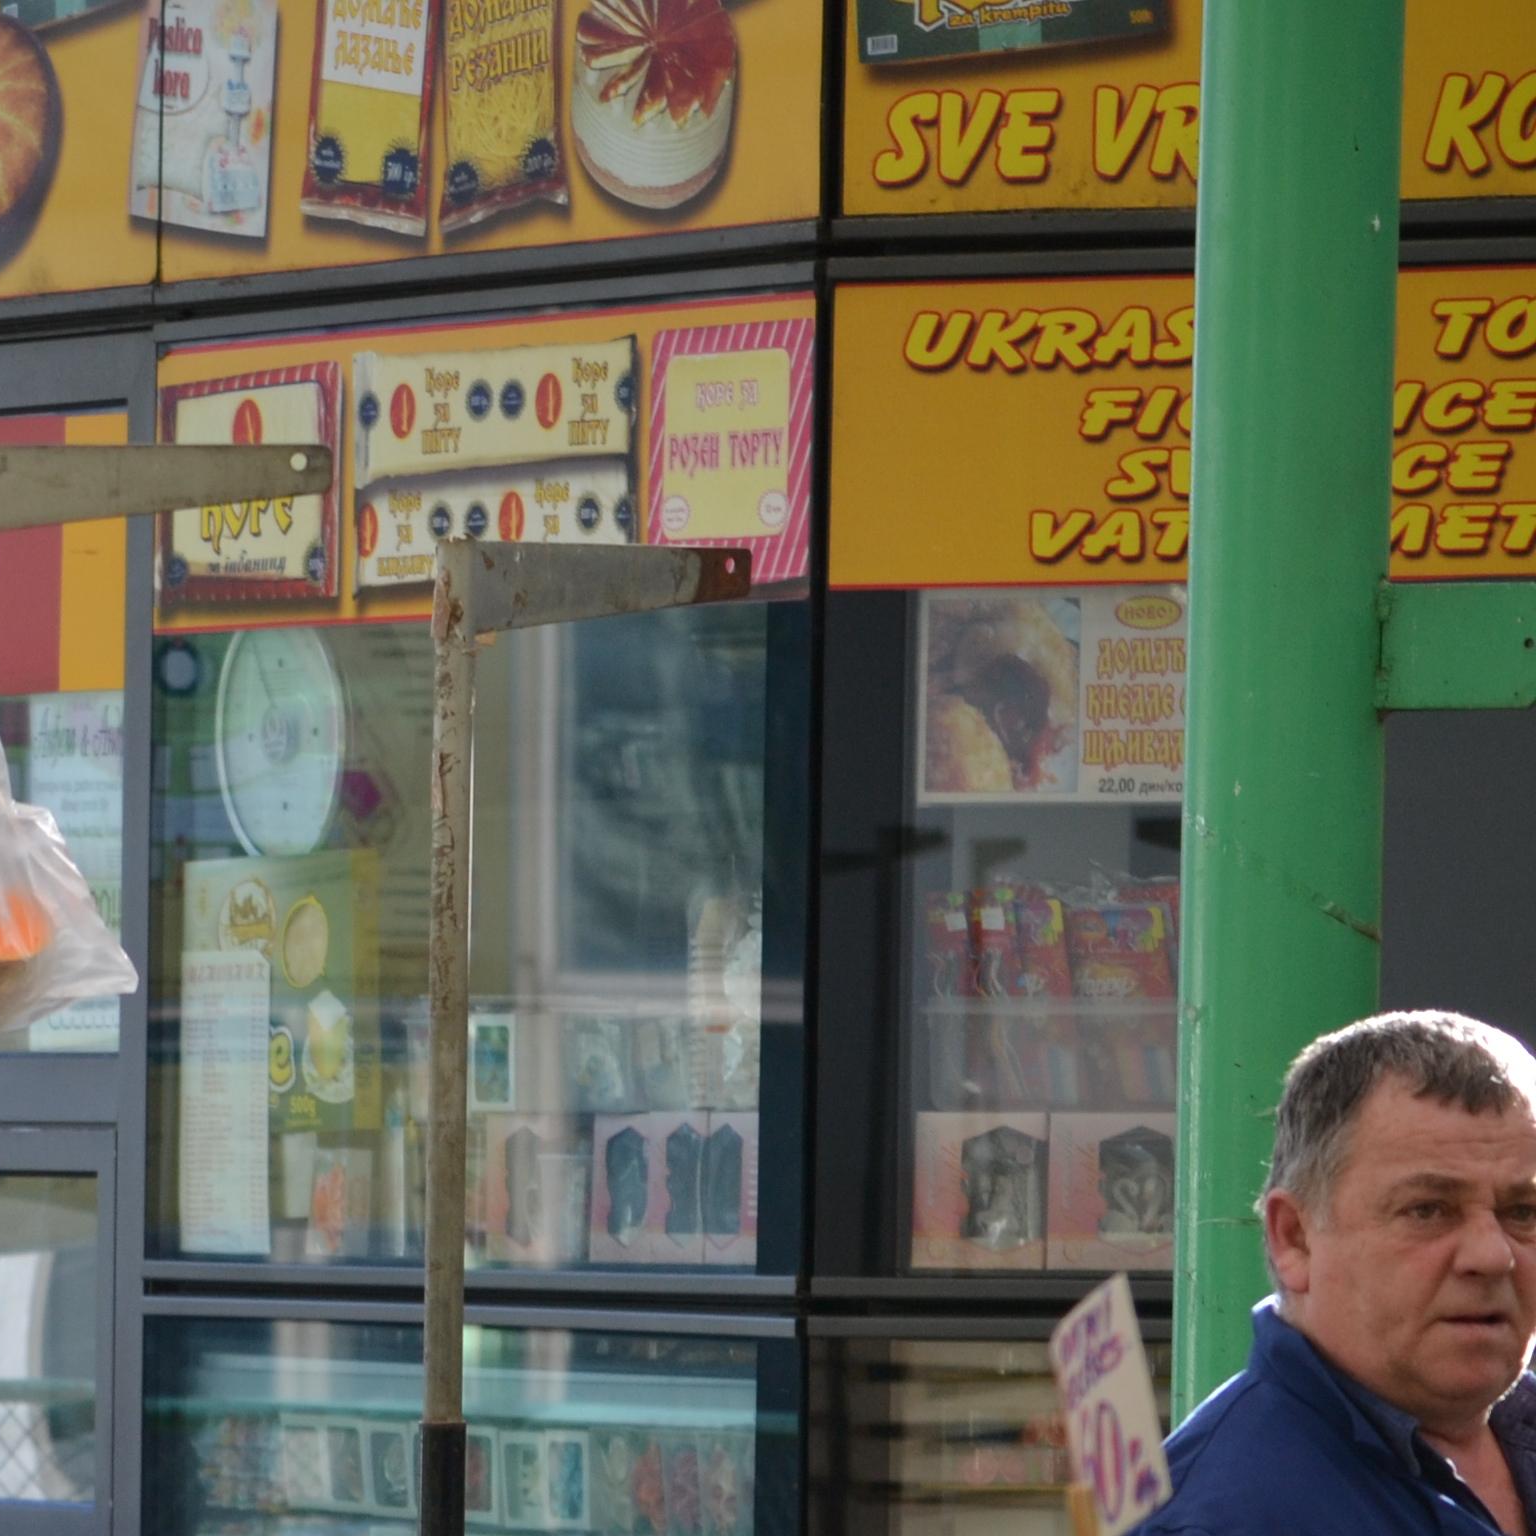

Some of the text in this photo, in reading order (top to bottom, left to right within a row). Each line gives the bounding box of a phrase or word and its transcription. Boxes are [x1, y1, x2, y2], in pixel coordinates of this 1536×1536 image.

[948, 3, 1069, 27] za krempitu
[333, 29, 415, 76] ЛАЗАЊЕ
[449, 27, 550, 92] РЕЗАНЦИ
[872, 88, 1062, 187] SVE
[668, 426, 784, 479] РОЗЕН ТОРТУ
[1085, 683, 1176, 726] КНЕДЛЕ
[1098, 777, 1136, 795] 22,00
